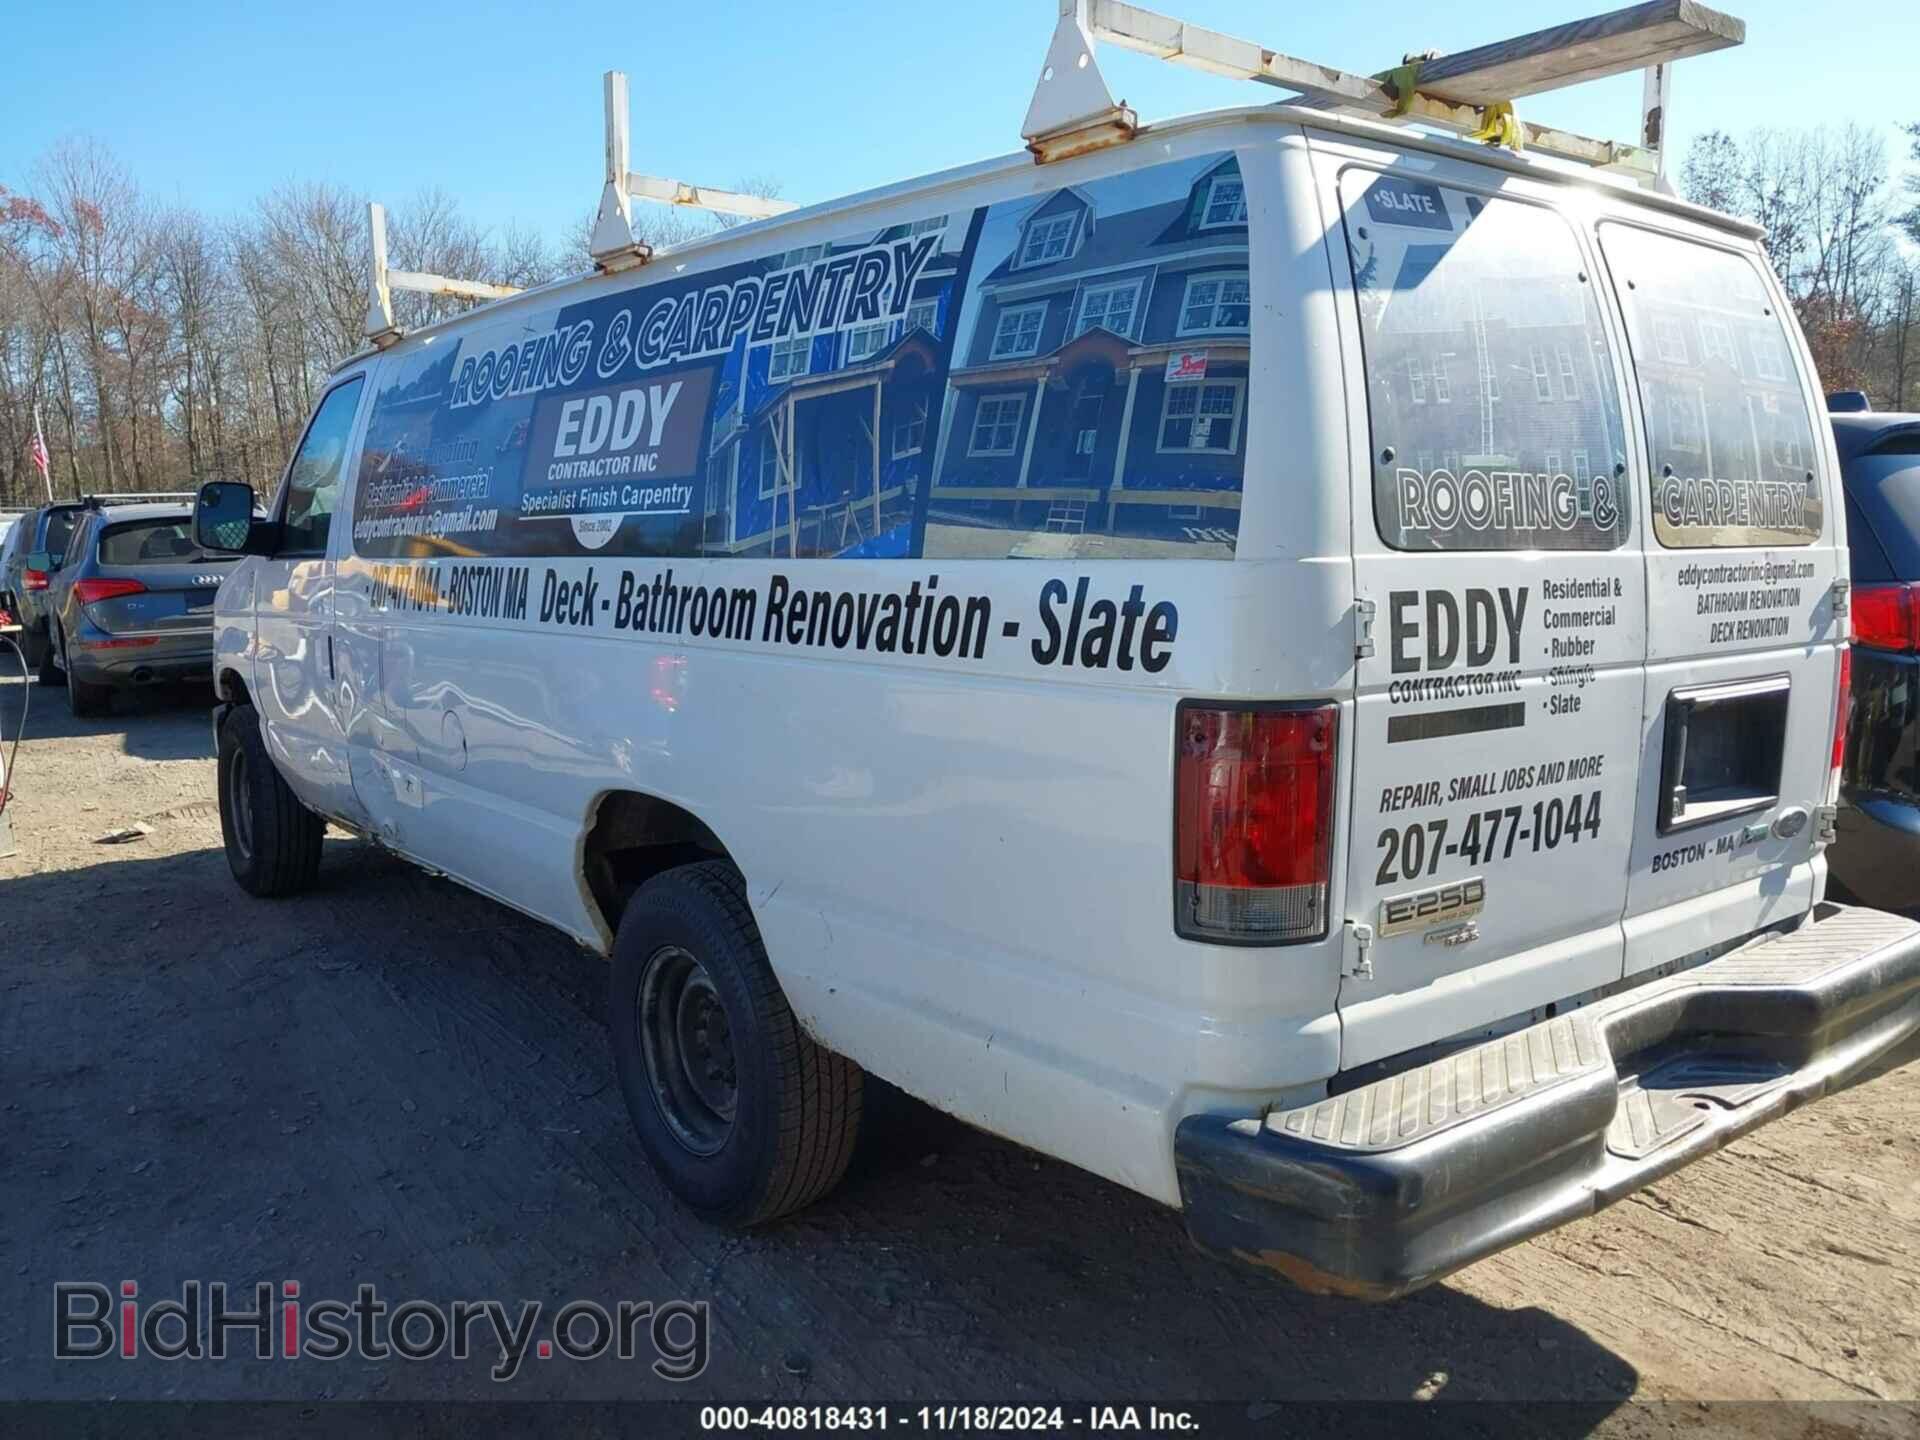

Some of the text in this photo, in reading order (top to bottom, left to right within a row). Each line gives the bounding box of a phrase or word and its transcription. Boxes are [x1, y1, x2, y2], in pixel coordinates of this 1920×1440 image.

[1380, 189, 1436, 214] SLATE
[450, 229, 946, 409] ROOFING & CARPENTRY
[553, 381, 683, 457] EDDY
[547, 452, 659, 481] CONTRACTOR INC
[521, 483, 694, 516] Specialist Finish Carpentry
[1397, 468, 1619, 531] ROOFING &
[1661, 475, 1808, 529] CARPENTRY
[578, 519, 598, 533] Since
[1543, 577, 1622, 600] Residential &
[1678, 560, 1815, 589] eddycontractorinc@gmail.com
[370, 566, 441, 612] 207-477-1044
[448, 566, 504, 618] BOSTON
[503, 567, 530, 620] MA
[1697, 587, 1801, 615] BATHROOM RENOVATION
[540, 567, 599, 626] Deck
[615, 569, 757, 641] Bathroom
[762, 574, 991, 659] Renovation
[1031, 576, 1179, 673] Slate
[1389, 587, 1529, 674] EDDY
[1543, 606, 1617, 629] Commercial
[1710, 616, 1789, 643] DECK RENOVATION
[1551, 638, 1595, 658] Rubber
[1388, 670, 1523, 704] CONTRACTOR INC
[1550, 694, 1582, 715] Slate
[1379, 754, 1605, 813] REPAIR, SMALL JOBS AND MORE
[1375, 790, 1603, 886] 207-477-1044
[1651, 842, 1706, 874] BOSTON
[1715, 835, 1735, 856] MA
